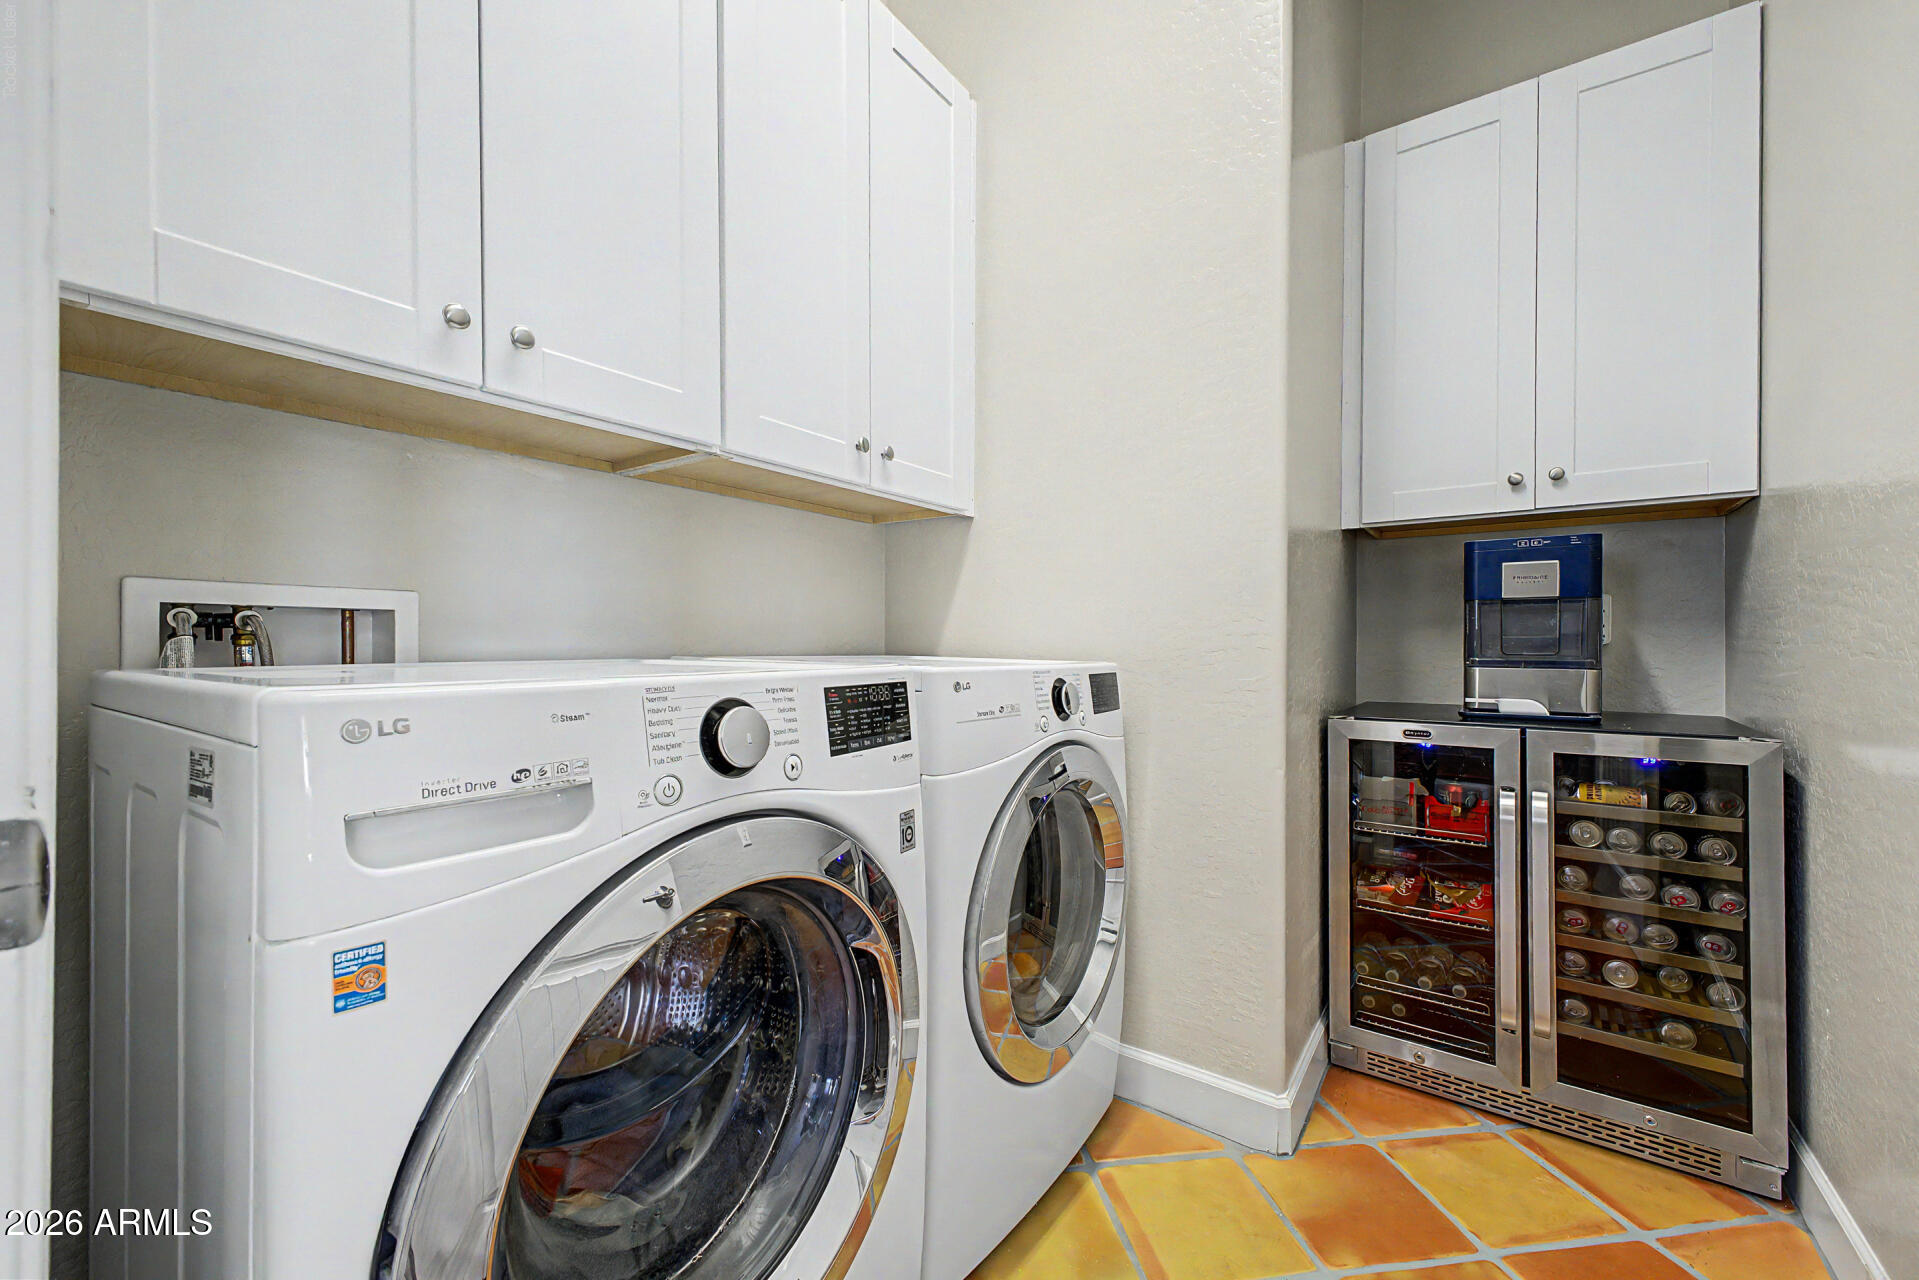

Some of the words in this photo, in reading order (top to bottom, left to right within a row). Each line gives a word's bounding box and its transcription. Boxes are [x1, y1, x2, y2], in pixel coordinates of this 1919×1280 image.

[962, 681, 971, 691] LG
[378, 718, 411, 737] LG
[649, 731, 676, 740] Sanitary
[653, 757, 665, 765] Tub
[665, 755, 683, 764] Clean
[421, 785, 465, 799] Direct
[465, 780, 497, 793] Drive
[334, 944, 384, 964] CERTIFIED
